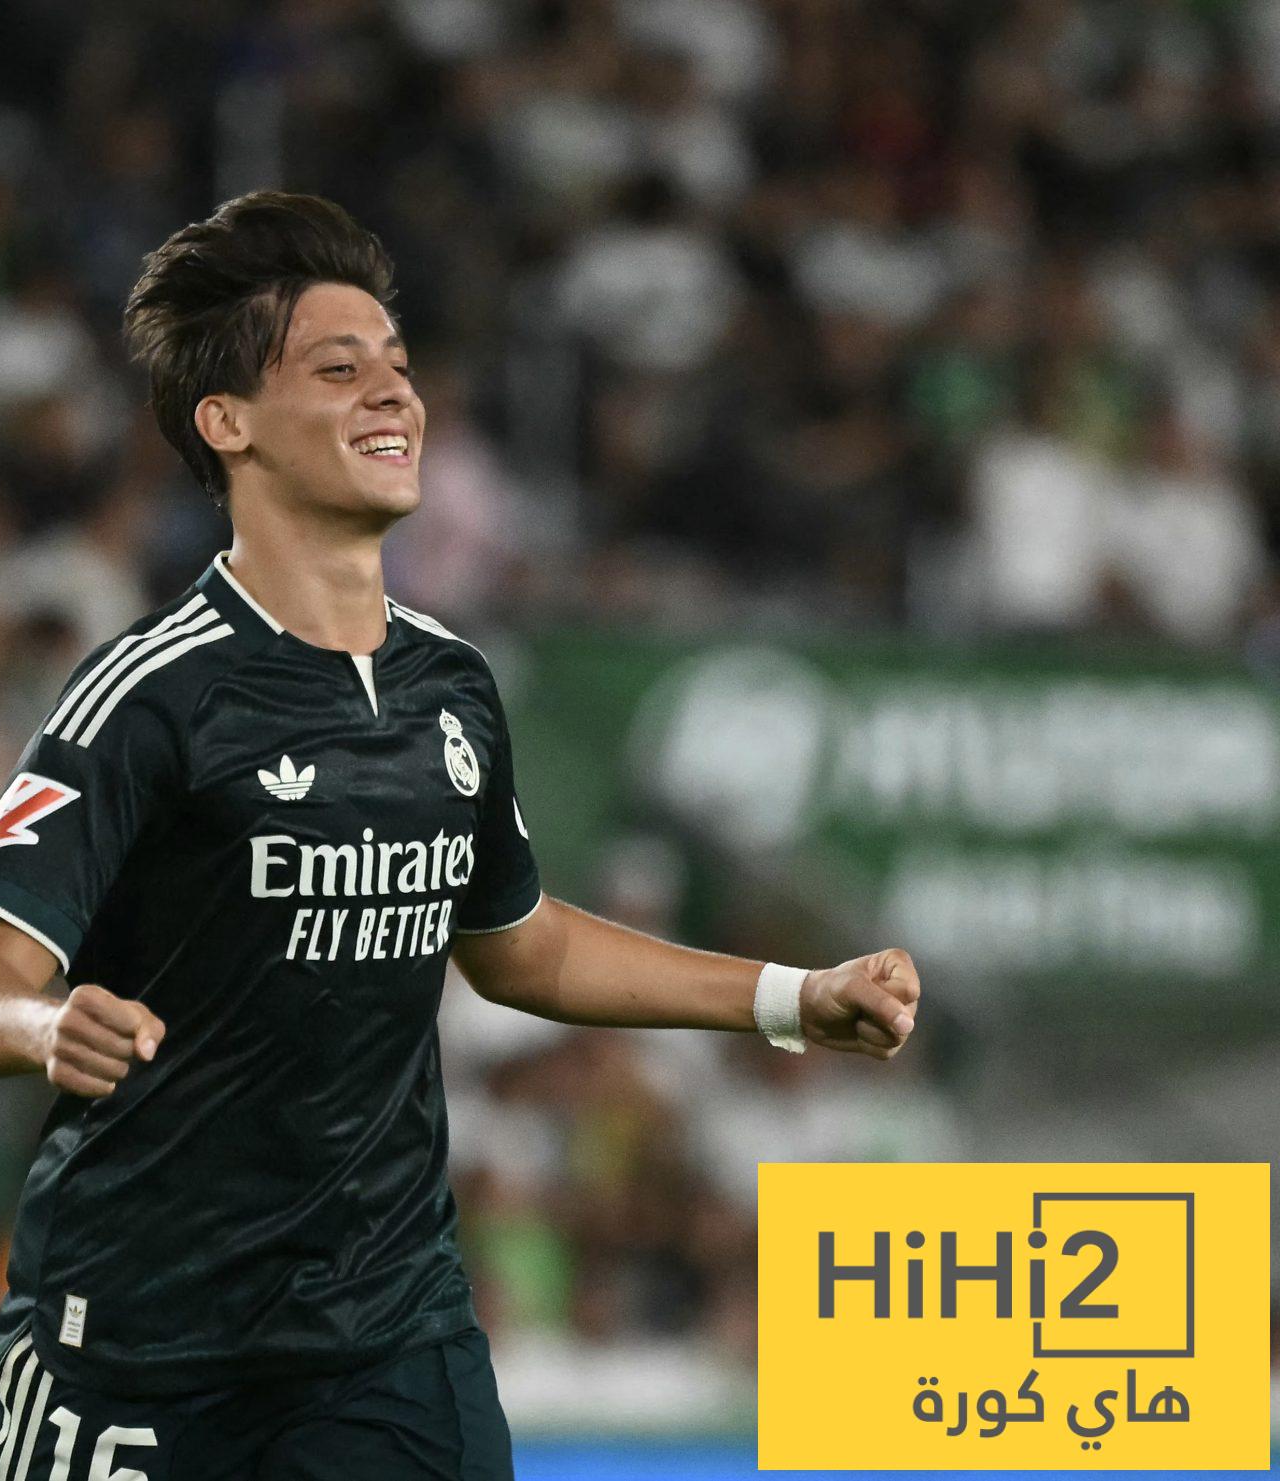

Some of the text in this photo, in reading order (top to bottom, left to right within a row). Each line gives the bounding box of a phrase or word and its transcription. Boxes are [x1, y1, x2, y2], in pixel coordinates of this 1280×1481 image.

[249, 827, 474, 898] Emirates
[285, 899, 453, 962] FLY BETTER
